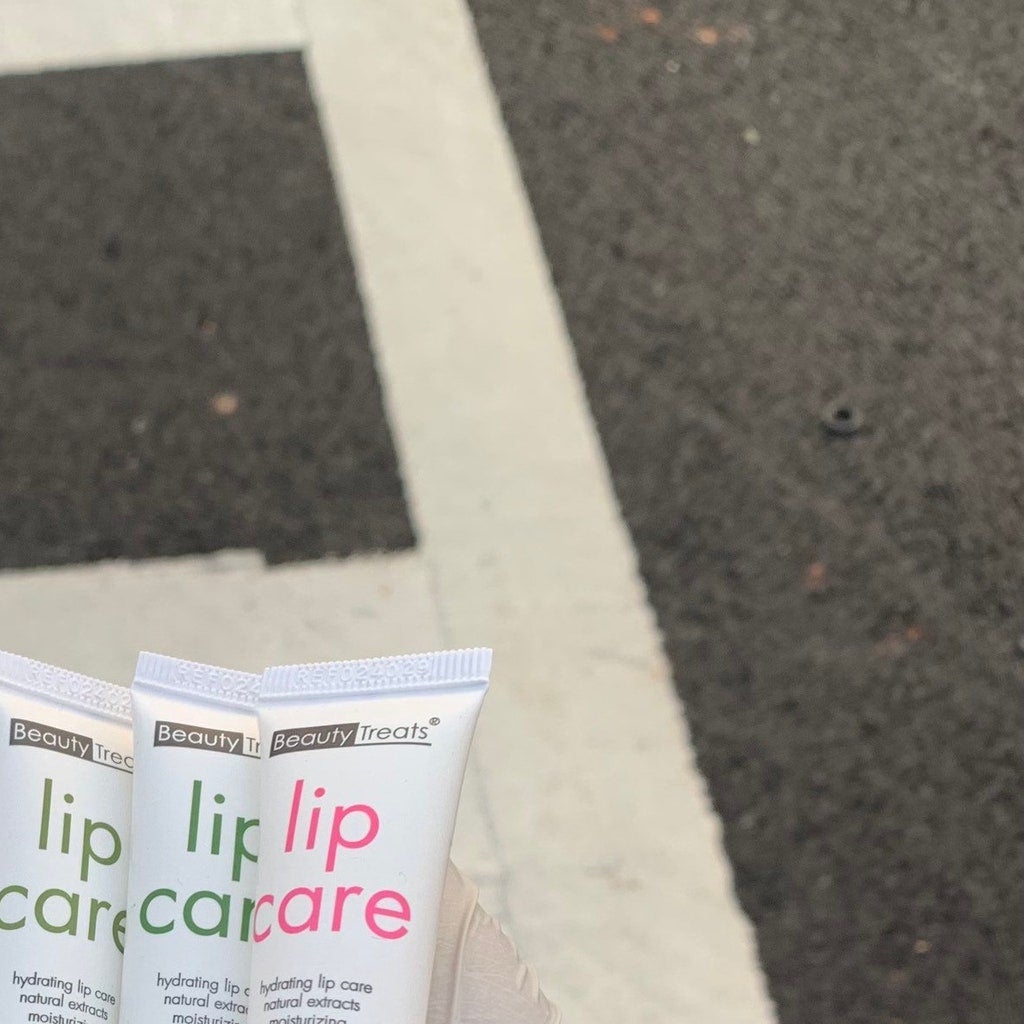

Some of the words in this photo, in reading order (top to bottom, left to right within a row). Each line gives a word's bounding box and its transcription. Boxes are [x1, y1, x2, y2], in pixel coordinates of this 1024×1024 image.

[14, 723, 90, 758] Beauty
[158, 725, 240, 752] Beauty
[273, 727, 355, 751] Beauty
[38, 777, 122, 882] lip
[284, 779, 380, 872] lip
[139, 888, 256, 942] car
[253, 886, 411, 943] care
[12, 971, 73, 995] hydrating
[77, 978, 92, 997] lip
[95, 989, 116, 1006] care
[157, 972, 219, 995] hydrating
[224, 978, 240, 998] lip
[260, 977, 312, 997] hydrating
[318, 973, 336, 991] lip
[340, 981, 373, 995] care
[20, 992, 64, 1007] natural
[68, 1000, 109, 1021] extracts
[164, 994, 210, 1009] natural
[263, 995, 302, 1012] natural
[307, 997, 360, 1012] extracts
